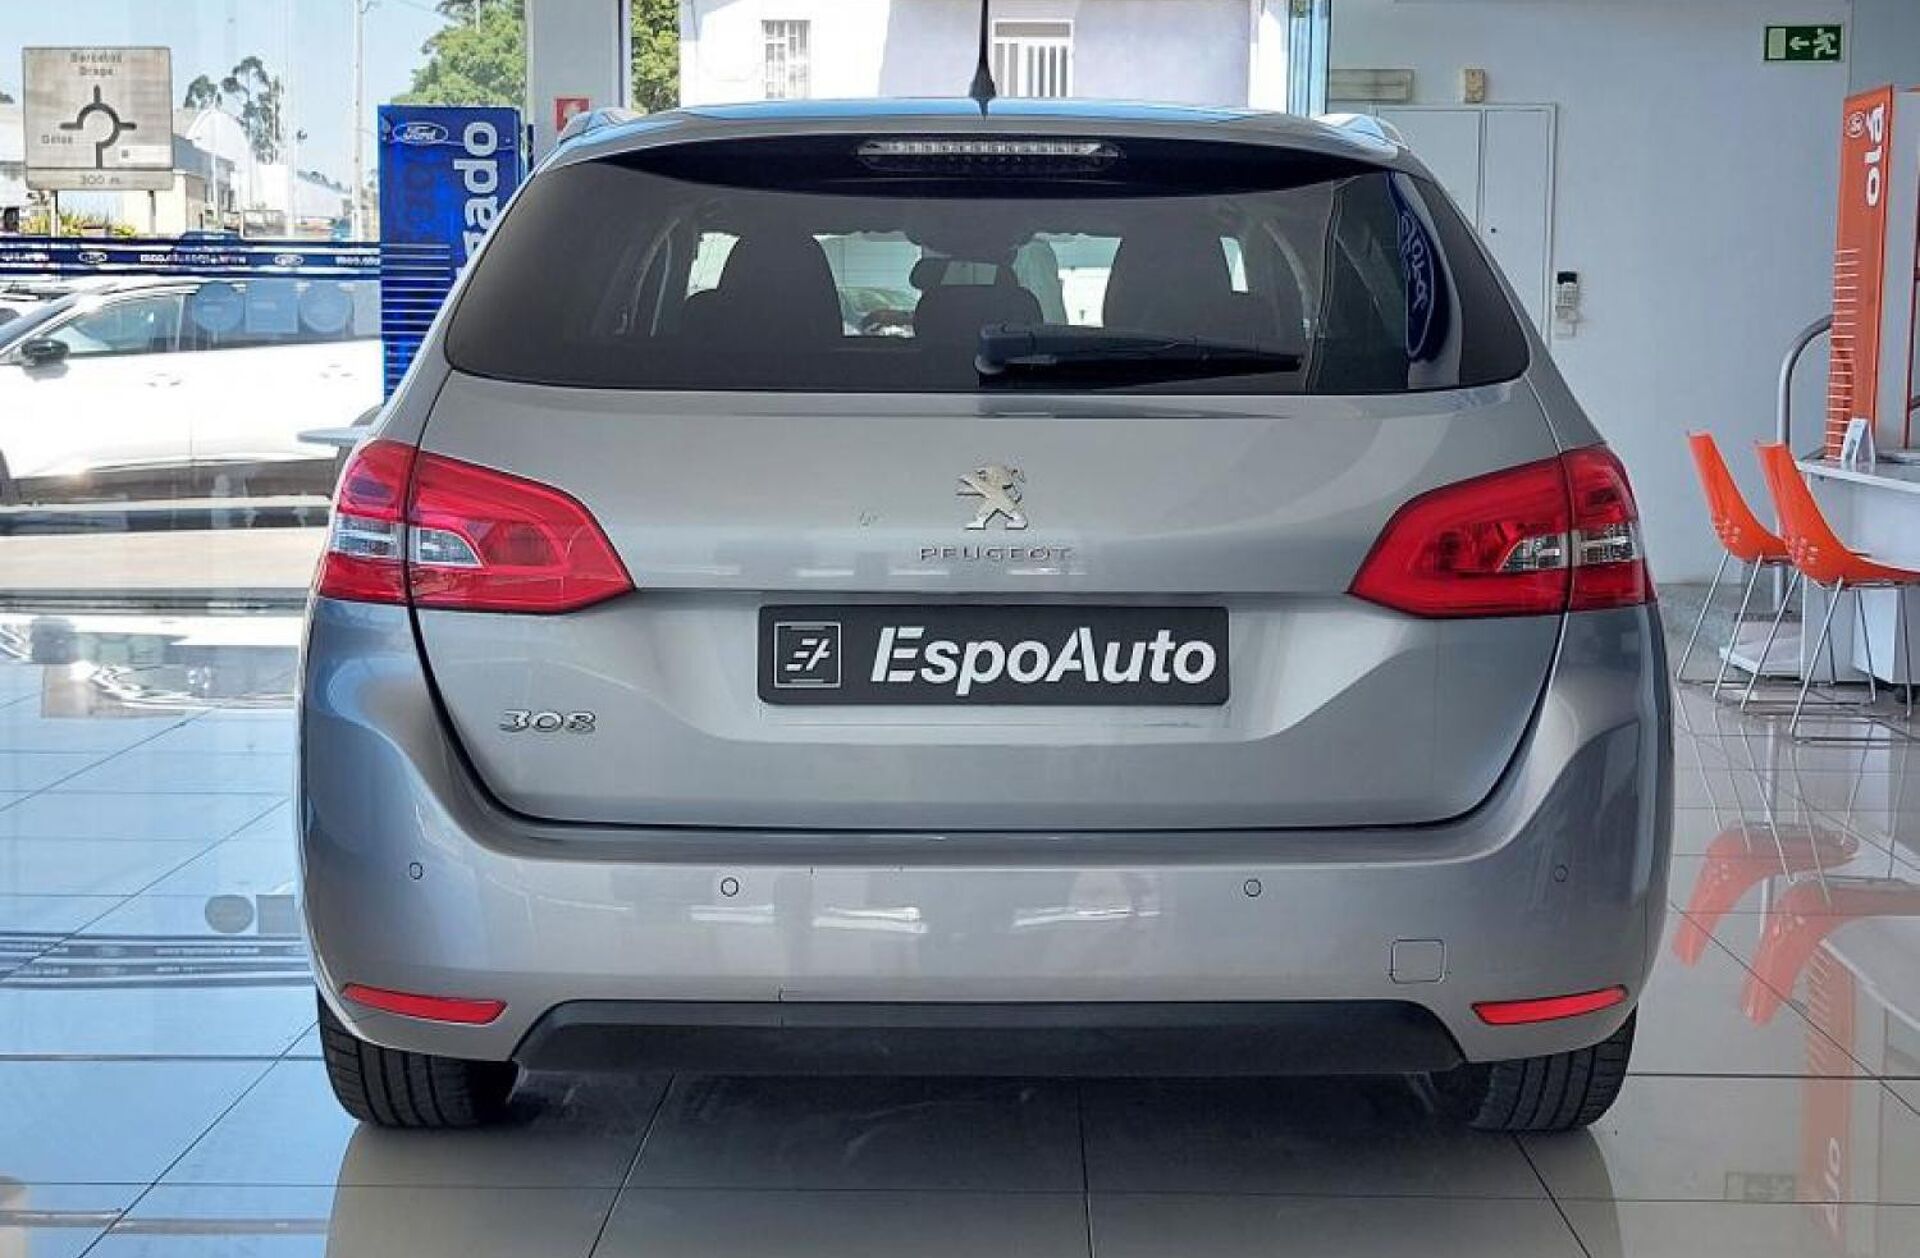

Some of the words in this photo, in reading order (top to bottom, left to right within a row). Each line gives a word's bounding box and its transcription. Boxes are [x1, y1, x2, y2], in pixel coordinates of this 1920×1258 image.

[80, 175, 104, 185] 300
[920, 547, 1073, 561] PEUGEOT
[870, 627, 1217, 696] EspoAuto
[499, 708, 596, 733] 308
